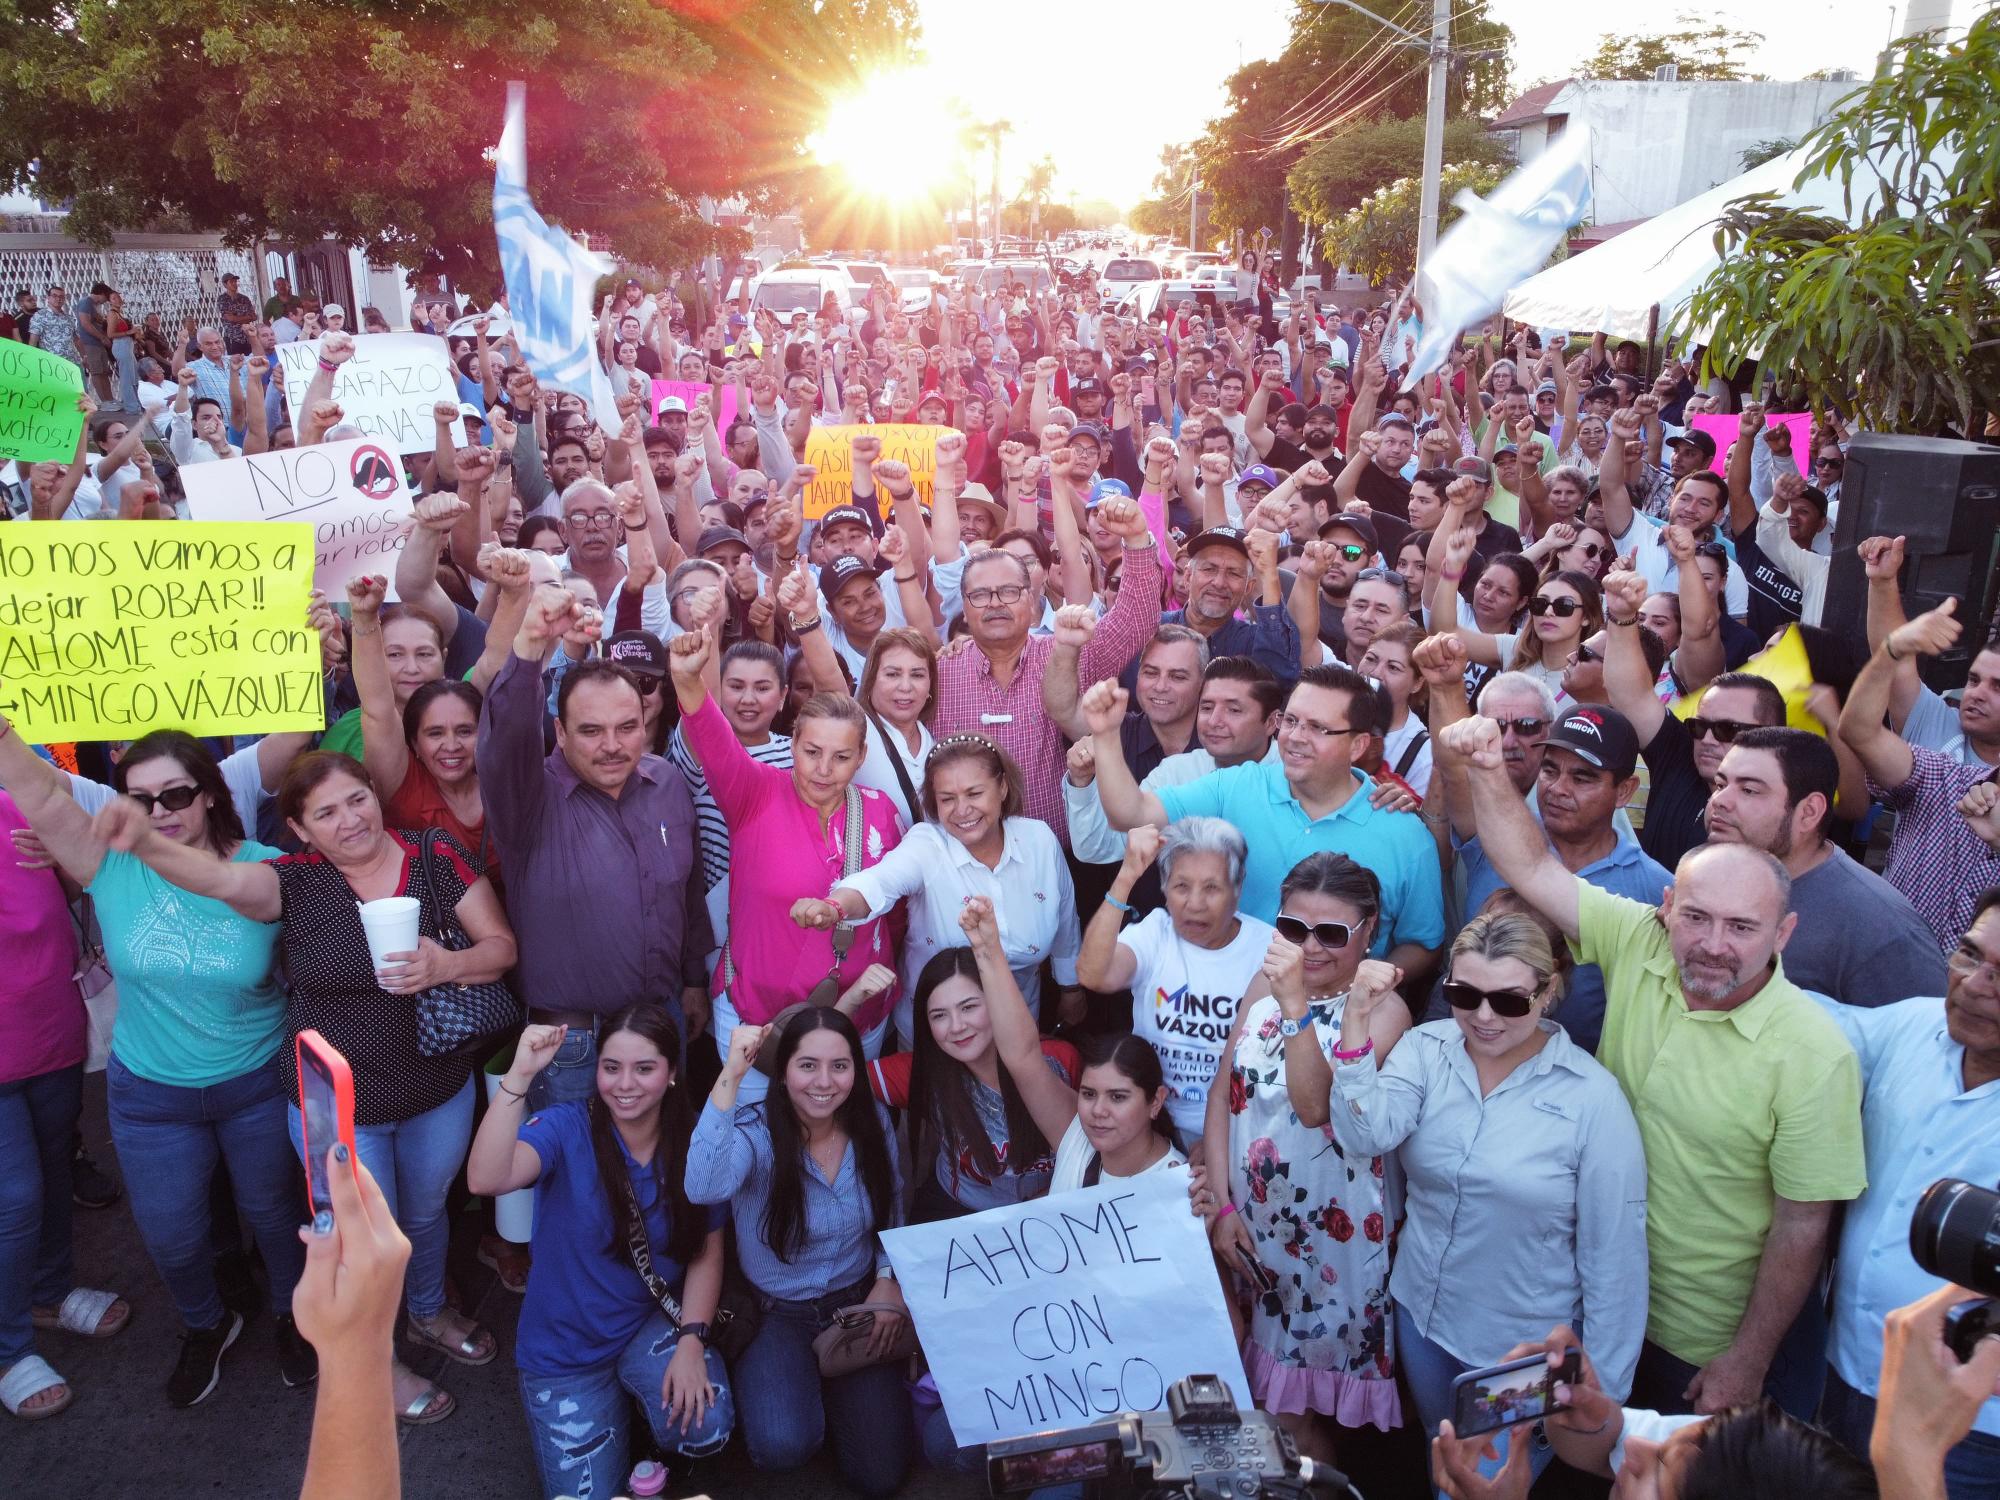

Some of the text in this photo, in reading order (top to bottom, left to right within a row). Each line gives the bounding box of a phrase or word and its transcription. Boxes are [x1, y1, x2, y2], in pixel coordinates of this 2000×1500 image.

[2, 350, 75, 384] os por
[282, 344, 318, 371] NO
[0, 385, 56, 416] ensa
[0, 446, 20, 457] uez
[246, 450, 336, 512] NO
[317, 509, 399, 543] amos
[49, 541, 117, 577] nos
[134, 539, 260, 571] vamos
[273, 544, 296, 571] a
[314, 546, 346, 567] ar
[0, 575, 265, 635] dejar ROBAR!!
[0, 619, 308, 675] AHOME está con
[21, 670, 324, 726] MINGO VÁZQUEZ!
[1155, 1014, 1231, 1042] VÁZQU
[1151, 1042, 1223, 1063] PRESID
[944, 1193, 1161, 1299] AHOME
[1013, 1294, 1113, 1361] CON
[984, 1357, 1164, 1430] MINGO
